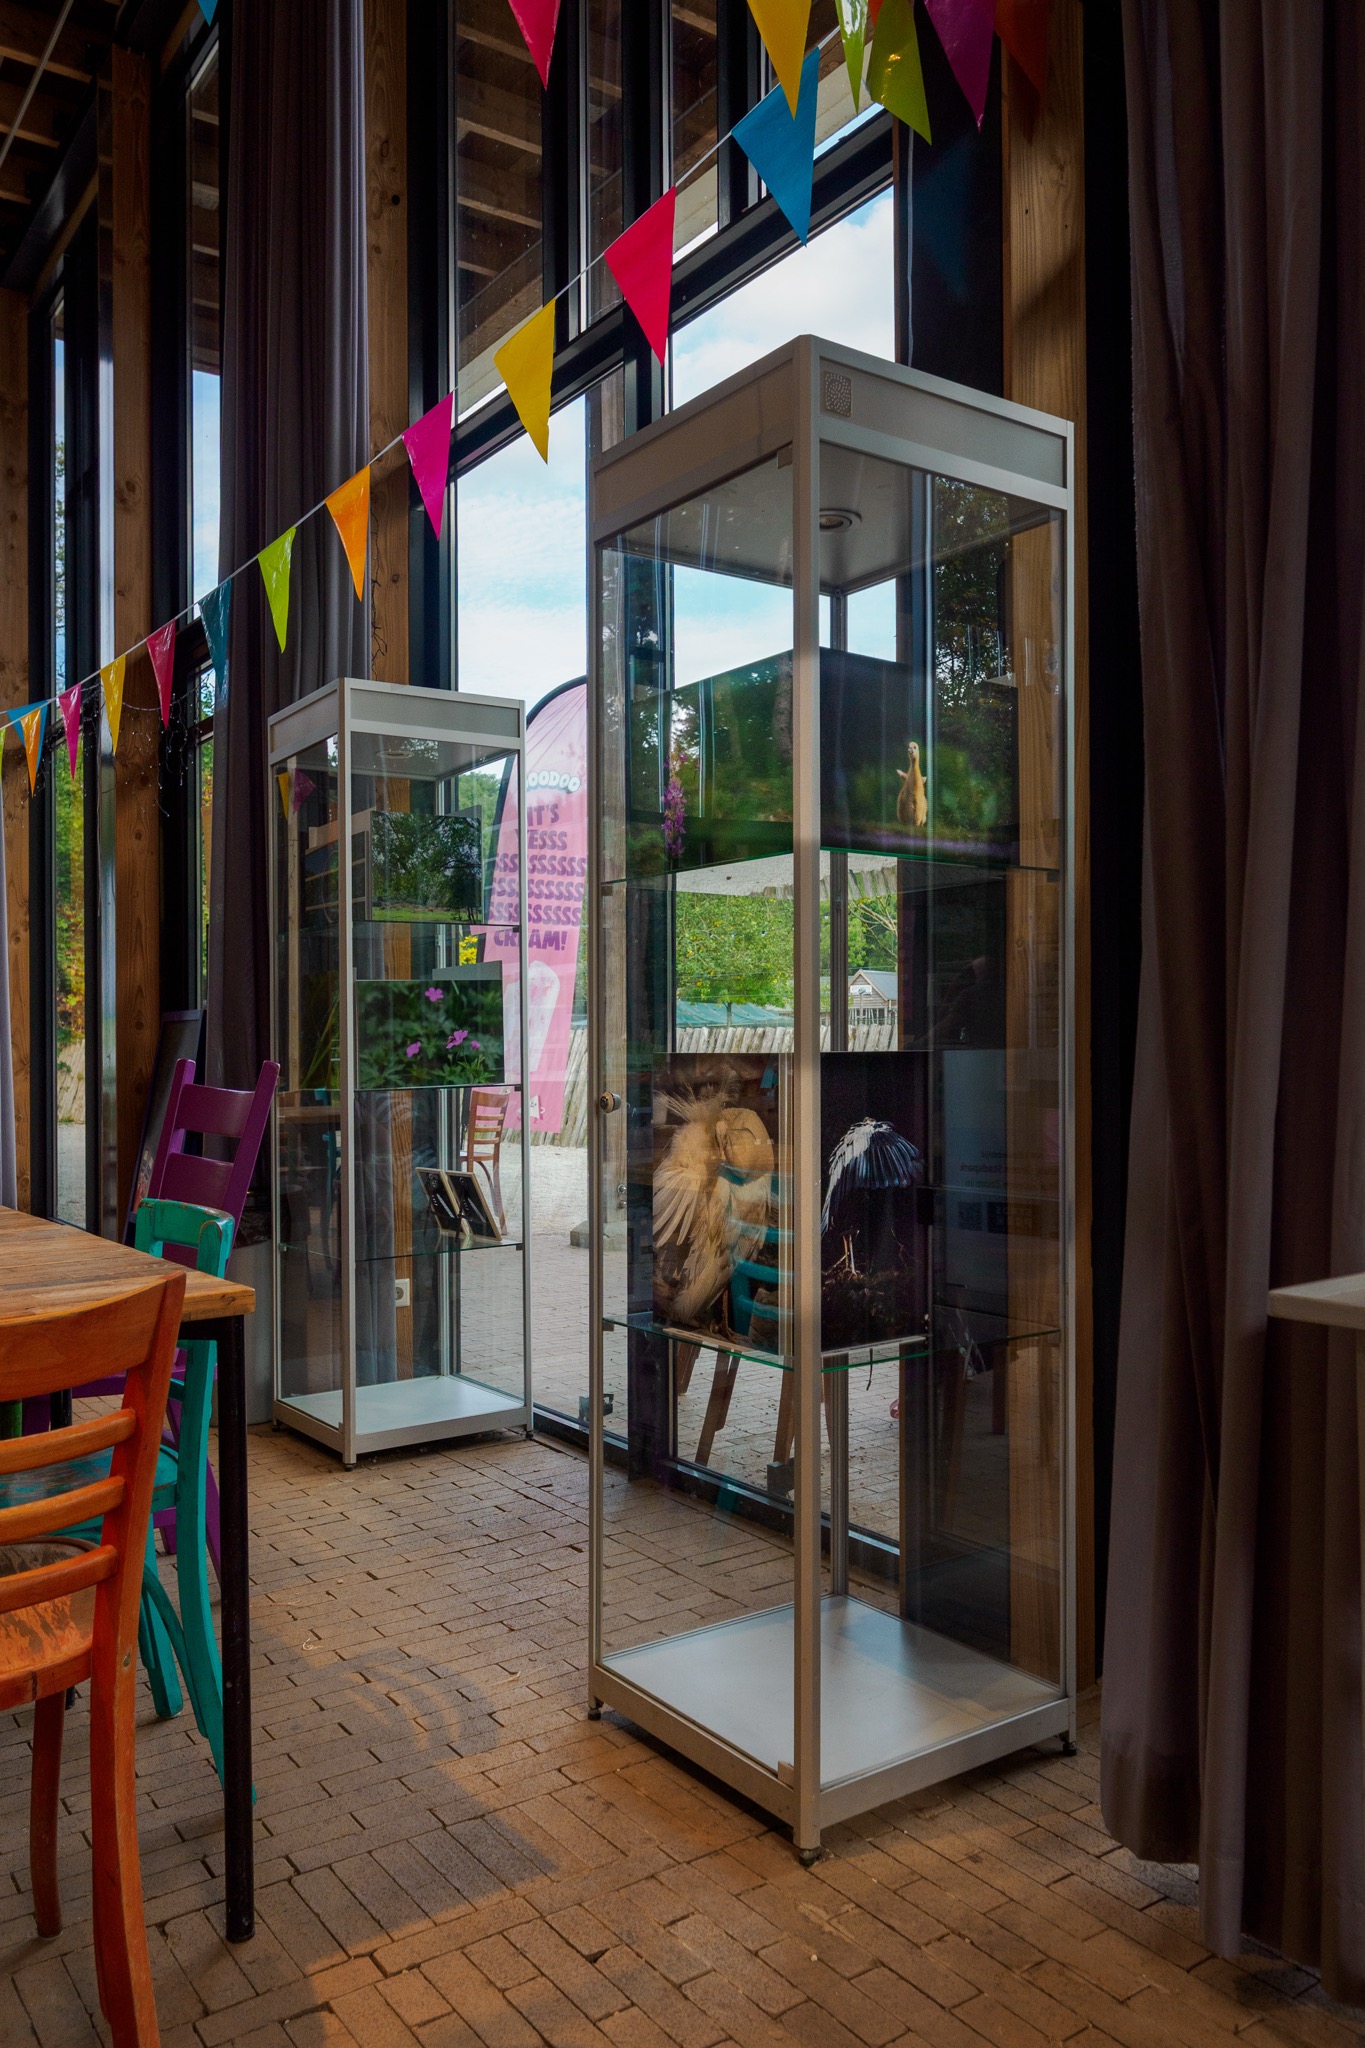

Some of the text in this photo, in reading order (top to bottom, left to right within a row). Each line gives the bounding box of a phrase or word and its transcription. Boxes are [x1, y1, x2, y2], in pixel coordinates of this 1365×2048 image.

[525, 770, 581, 794] OODOO
[527, 804, 559, 827] IT'S
[493, 928, 568, 951] CRAM!
